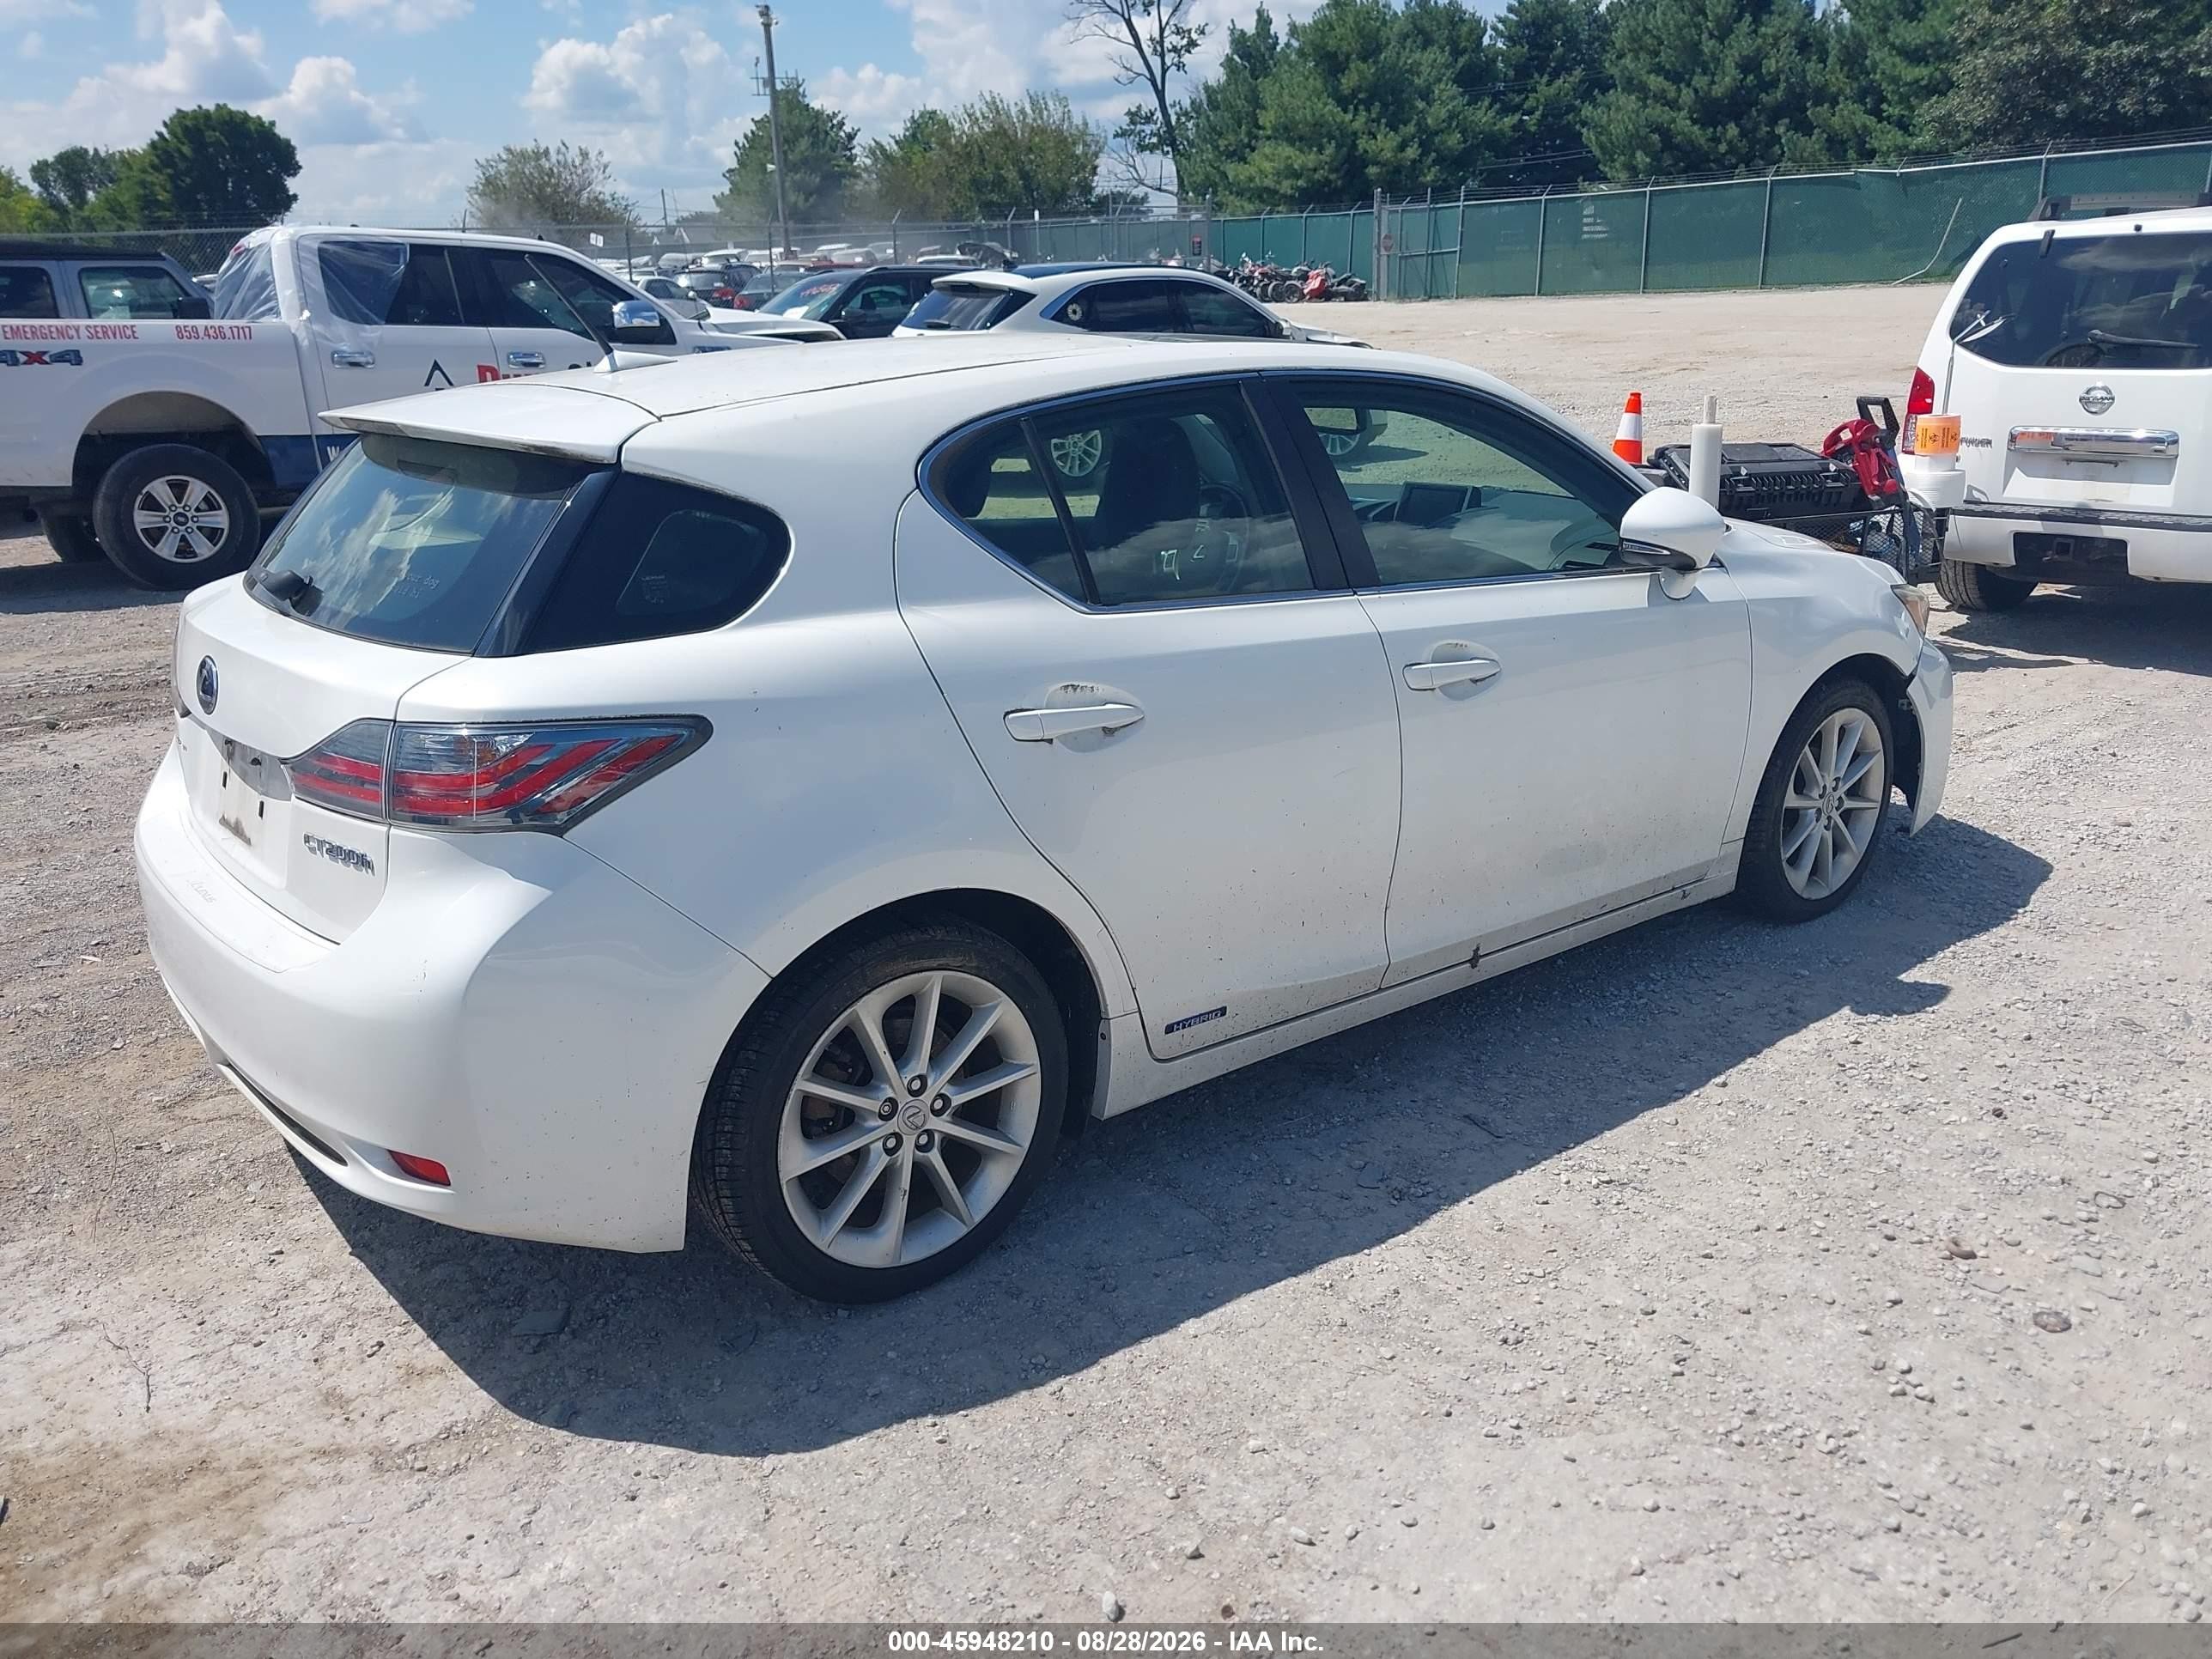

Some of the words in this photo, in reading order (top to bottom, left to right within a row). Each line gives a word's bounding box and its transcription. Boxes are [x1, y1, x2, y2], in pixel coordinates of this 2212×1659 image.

[3, 324, 82, 341] EMERGENCY
[86, 325, 139, 341] SERVICE
[175, 325, 252, 341] 859.436.1717
[1173, 1010, 1221, 1031] HYBRID
